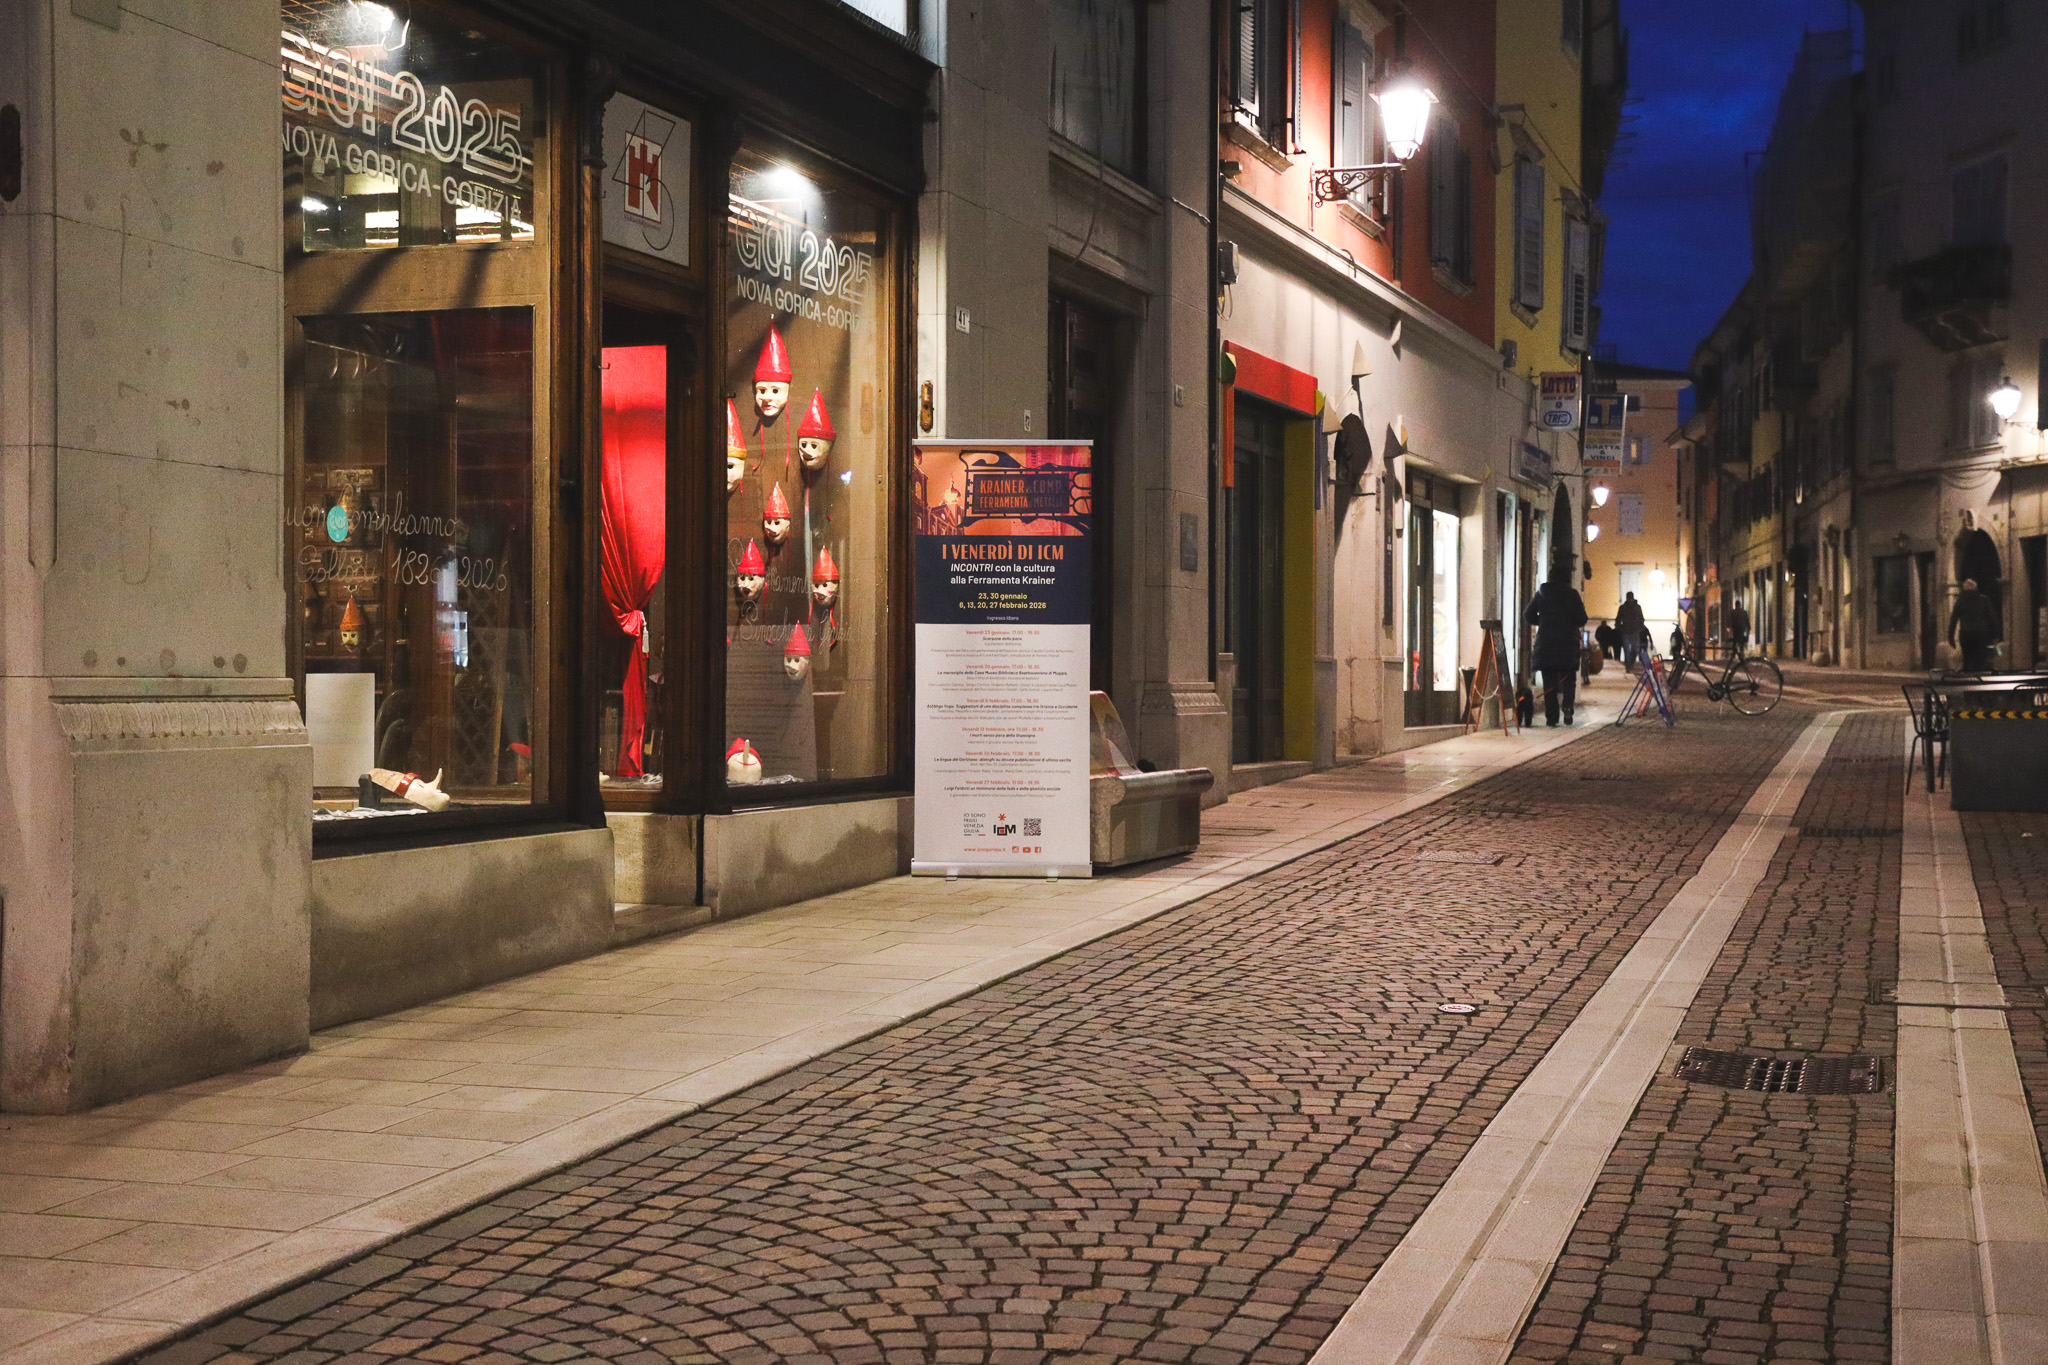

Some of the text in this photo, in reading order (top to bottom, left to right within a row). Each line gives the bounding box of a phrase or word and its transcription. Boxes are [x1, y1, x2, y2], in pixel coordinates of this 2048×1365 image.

[390, 70, 524, 185] 2025
[735, 208, 874, 306] GO! 2025
[737, 274, 773, 307] NOVA
[1541, 376, 1577, 394] LOTTO
[1595, 398, 1618, 425] T
[980, 480, 1025, 494] KRAINER
[979, 496, 1028, 508] FERRAMENTA
[942, 541, 1064, 560] I VENERDÌ DI ICM
[457, 555, 509, 592] 2026
[950, 563, 1056, 573] INCONTRI con la cultura
[950, 576, 1056, 585] alla Ferramenta Krainer
[959, 602, 966, 610] 6,
[967, 602, 976, 610] 13,
[977, 602, 988, 610] 20,
[978, 592, 1028, 602] 23, 30 gennaio
